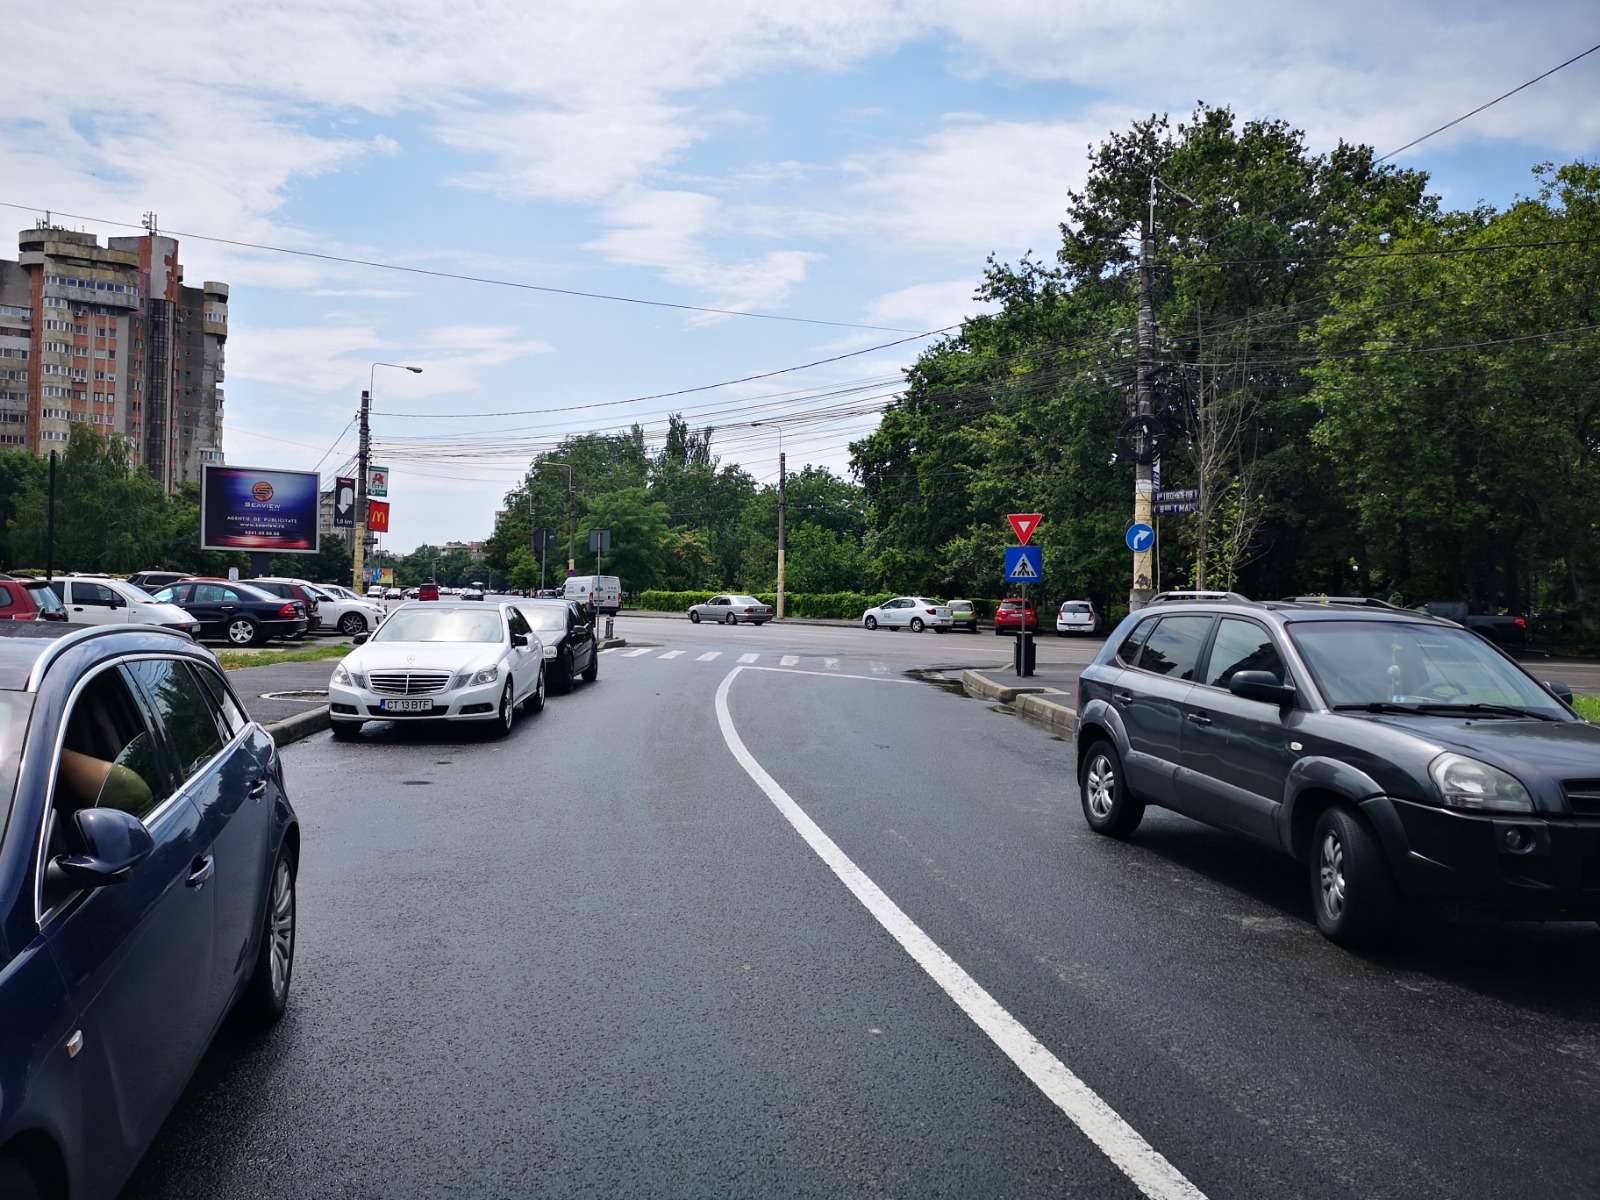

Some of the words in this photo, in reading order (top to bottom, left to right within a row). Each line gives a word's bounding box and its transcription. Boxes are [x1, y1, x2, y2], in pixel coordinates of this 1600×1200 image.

[387, 701, 398, 709] CT
[401, 701, 410, 709] 13
[411, 701, 430, 709] BTF
